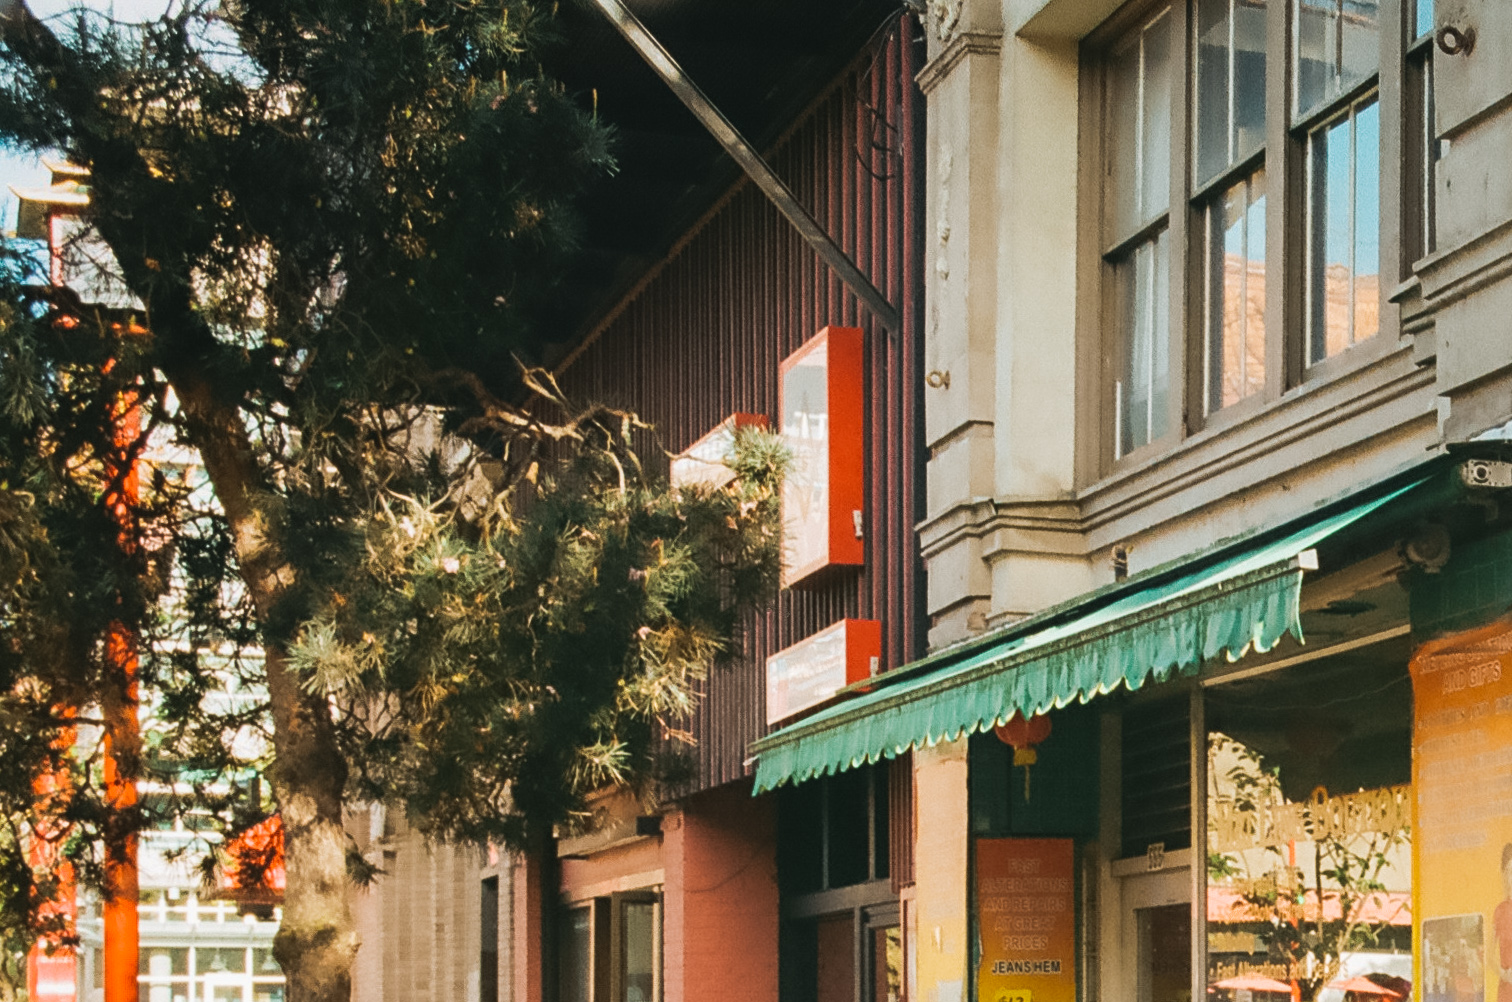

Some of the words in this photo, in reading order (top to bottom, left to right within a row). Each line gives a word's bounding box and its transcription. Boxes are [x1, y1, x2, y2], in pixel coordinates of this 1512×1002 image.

[1468, 659, 1501, 688] GIFTS
[1003, 935, 1048, 951] PRICES
[992, 961, 1032, 974] JEANS
[1033, 960, 1061, 973] HEM
